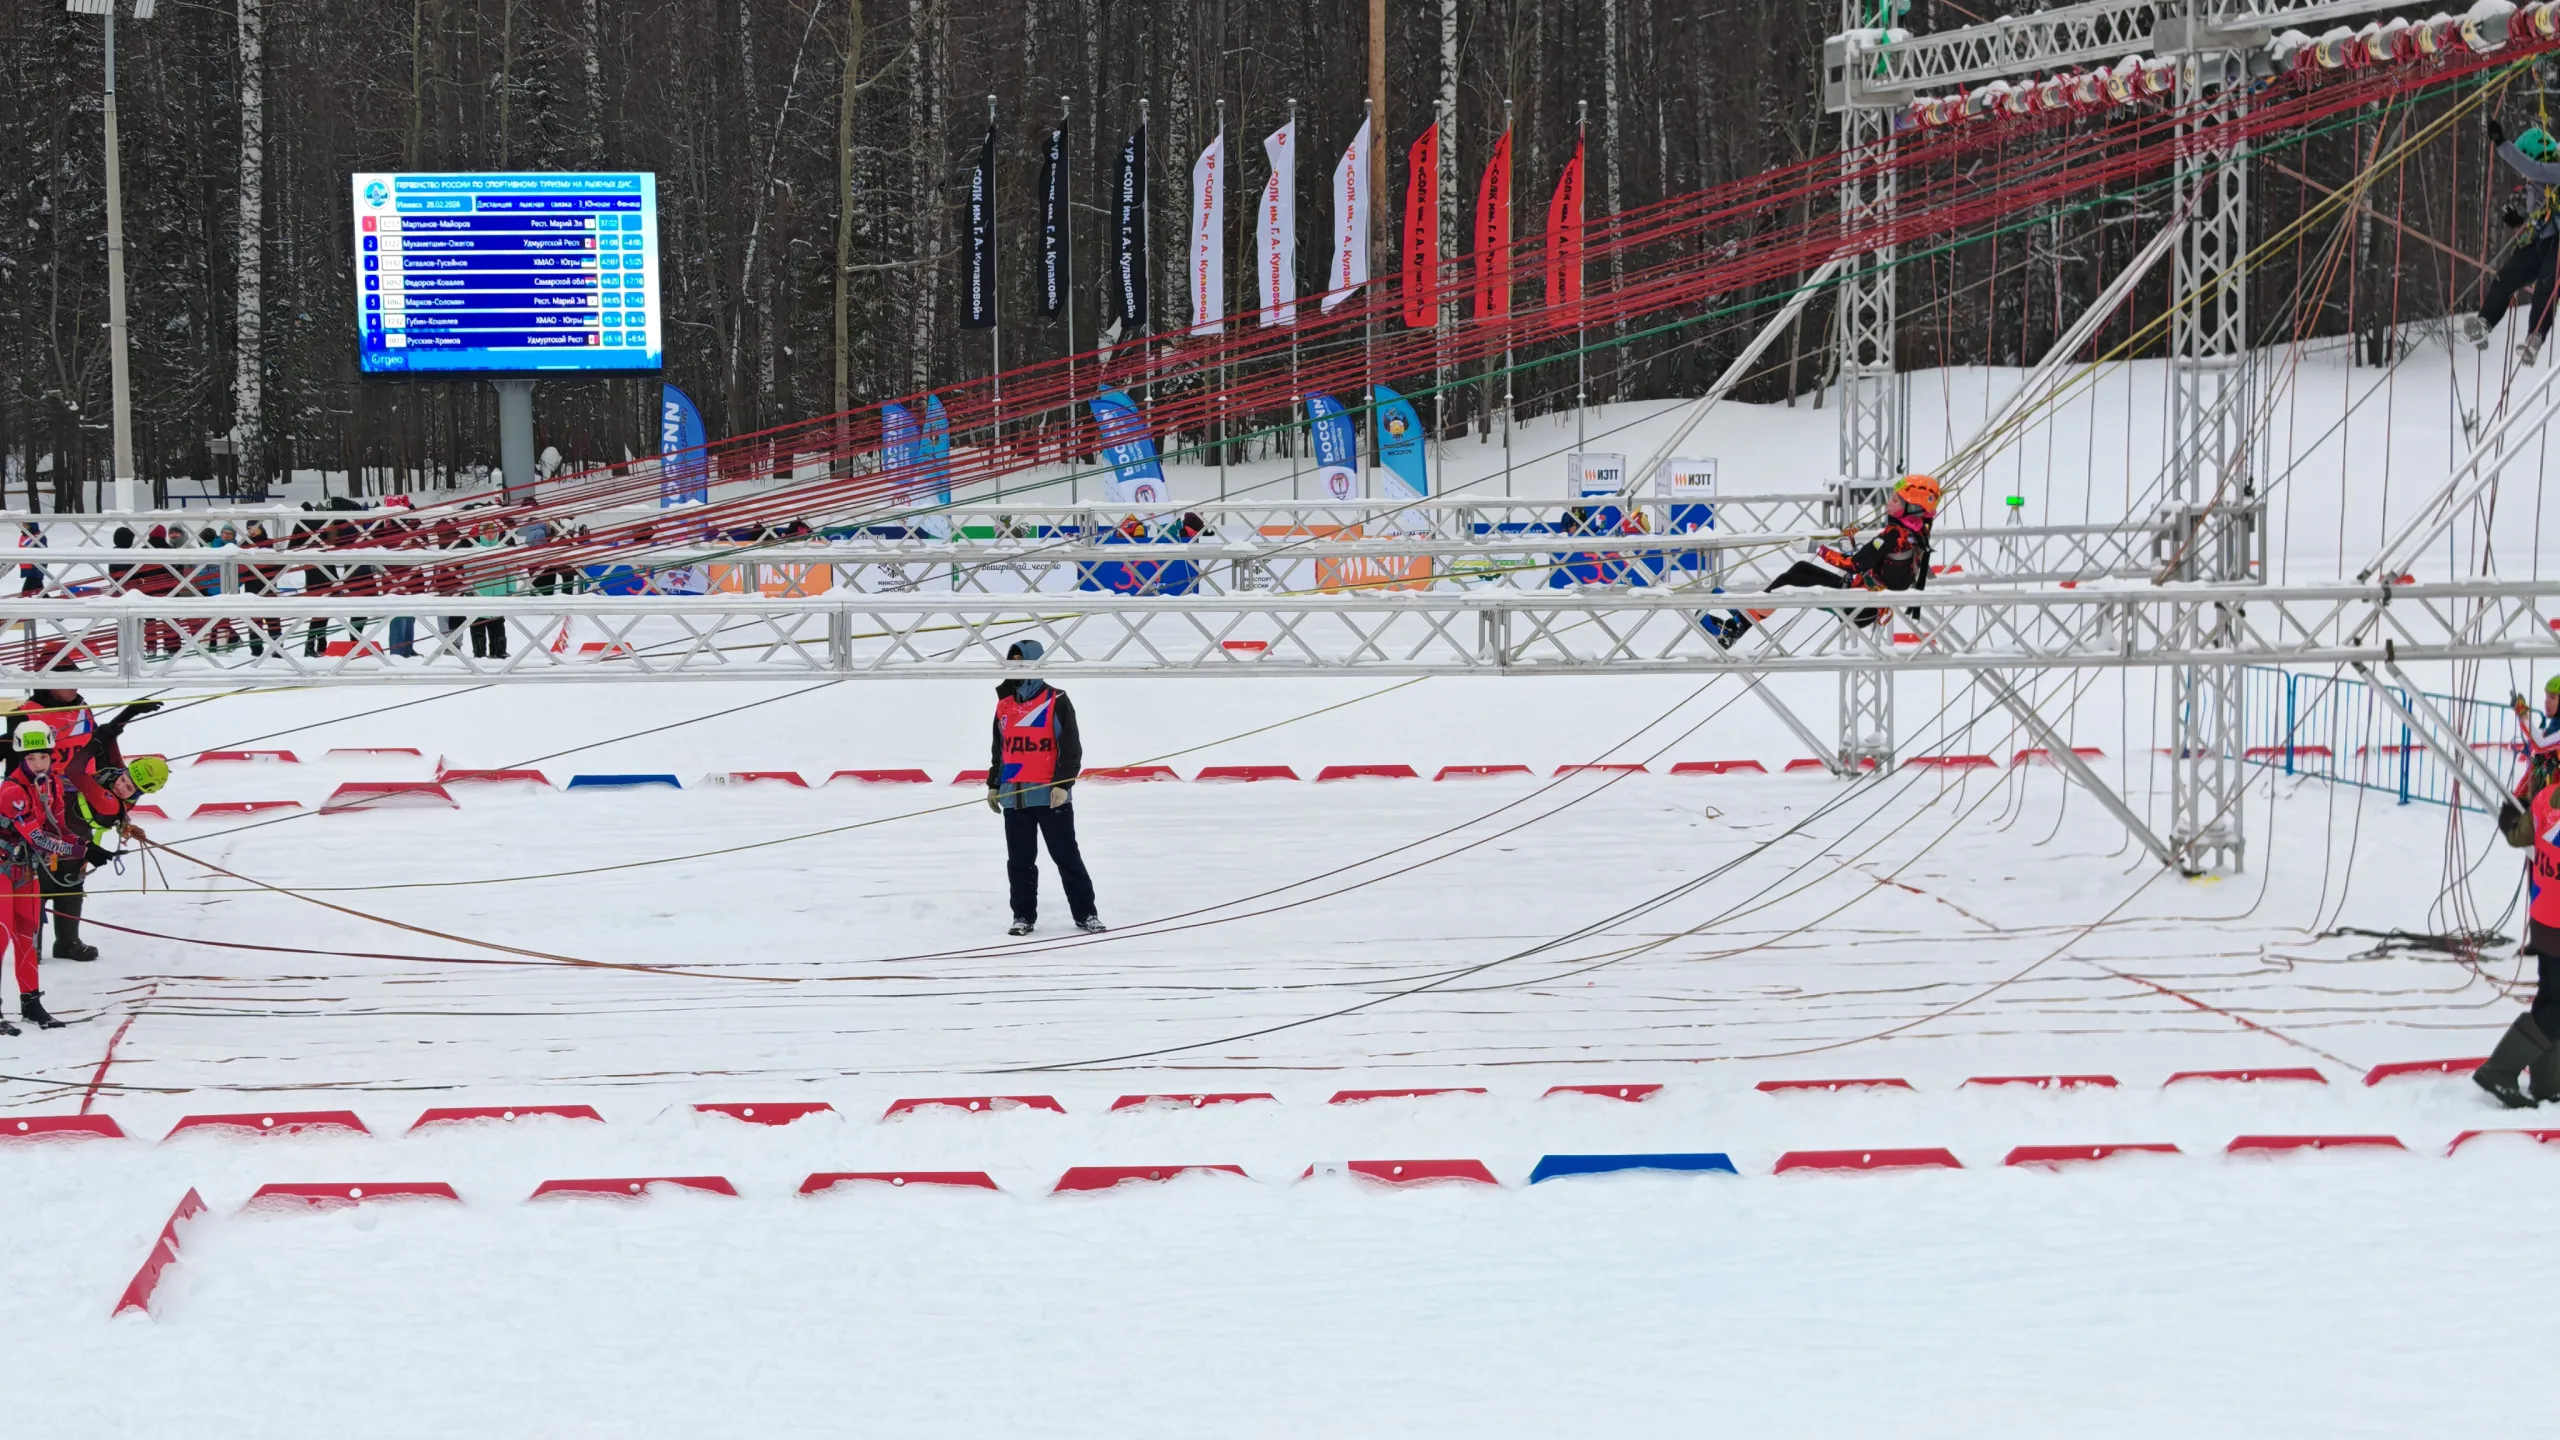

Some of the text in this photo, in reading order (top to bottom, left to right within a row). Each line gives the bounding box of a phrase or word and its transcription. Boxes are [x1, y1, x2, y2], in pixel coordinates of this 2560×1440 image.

[1124, 147, 1134, 162] УР
[1206, 154, 1215, 169] УР
[396, 181, 439, 189] ПЕРВЕНСТВО
[485, 180, 537, 188] СПОРТИВНОМУ
[540, 180, 571, 188] ТУРИЗМУ
[972, 167, 983, 202] СОЛК
[1564, 166, 1574, 200] СОЛК
[477, 201, 512, 209] Дистанция
[973, 204, 981, 224] им.
[1122, 205, 1131, 224] им.
[1269, 206, 1278, 225] им.
[1346, 205, 1354, 224] им.
[402, 220, 470, 229] Мартынов-Майоров
[550, 219, 572, 228] Марий
[974, 226, 984, 236] Г.
[1122, 226, 1131, 235] Г.
[1270, 227, 1280, 236] Г.
[523, 239, 562, 248] Удмуртской
[974, 237, 984, 250] А.
[1046, 236, 1056, 249] А.
[1122, 238, 1131, 250] А.
[1270, 238, 1281, 250] А.
[1343, 236, 1352, 248] А.
[1200, 245, 1209, 256] А.
[561, 258, 580, 267] Югры
[534, 278, 571, 287] Самарской
[552, 297, 575, 306] Марий
[406, 318, 458, 327] Губин-Кошелев
[563, 317, 582, 325] Югры
[527, 336, 566, 345] Удмуртской
[1597, 469, 1619, 480] ИЗТТ
[1688, 474, 1711, 486] ИЗТТ
[1003, 736, 1051, 754] УДЬЯ
